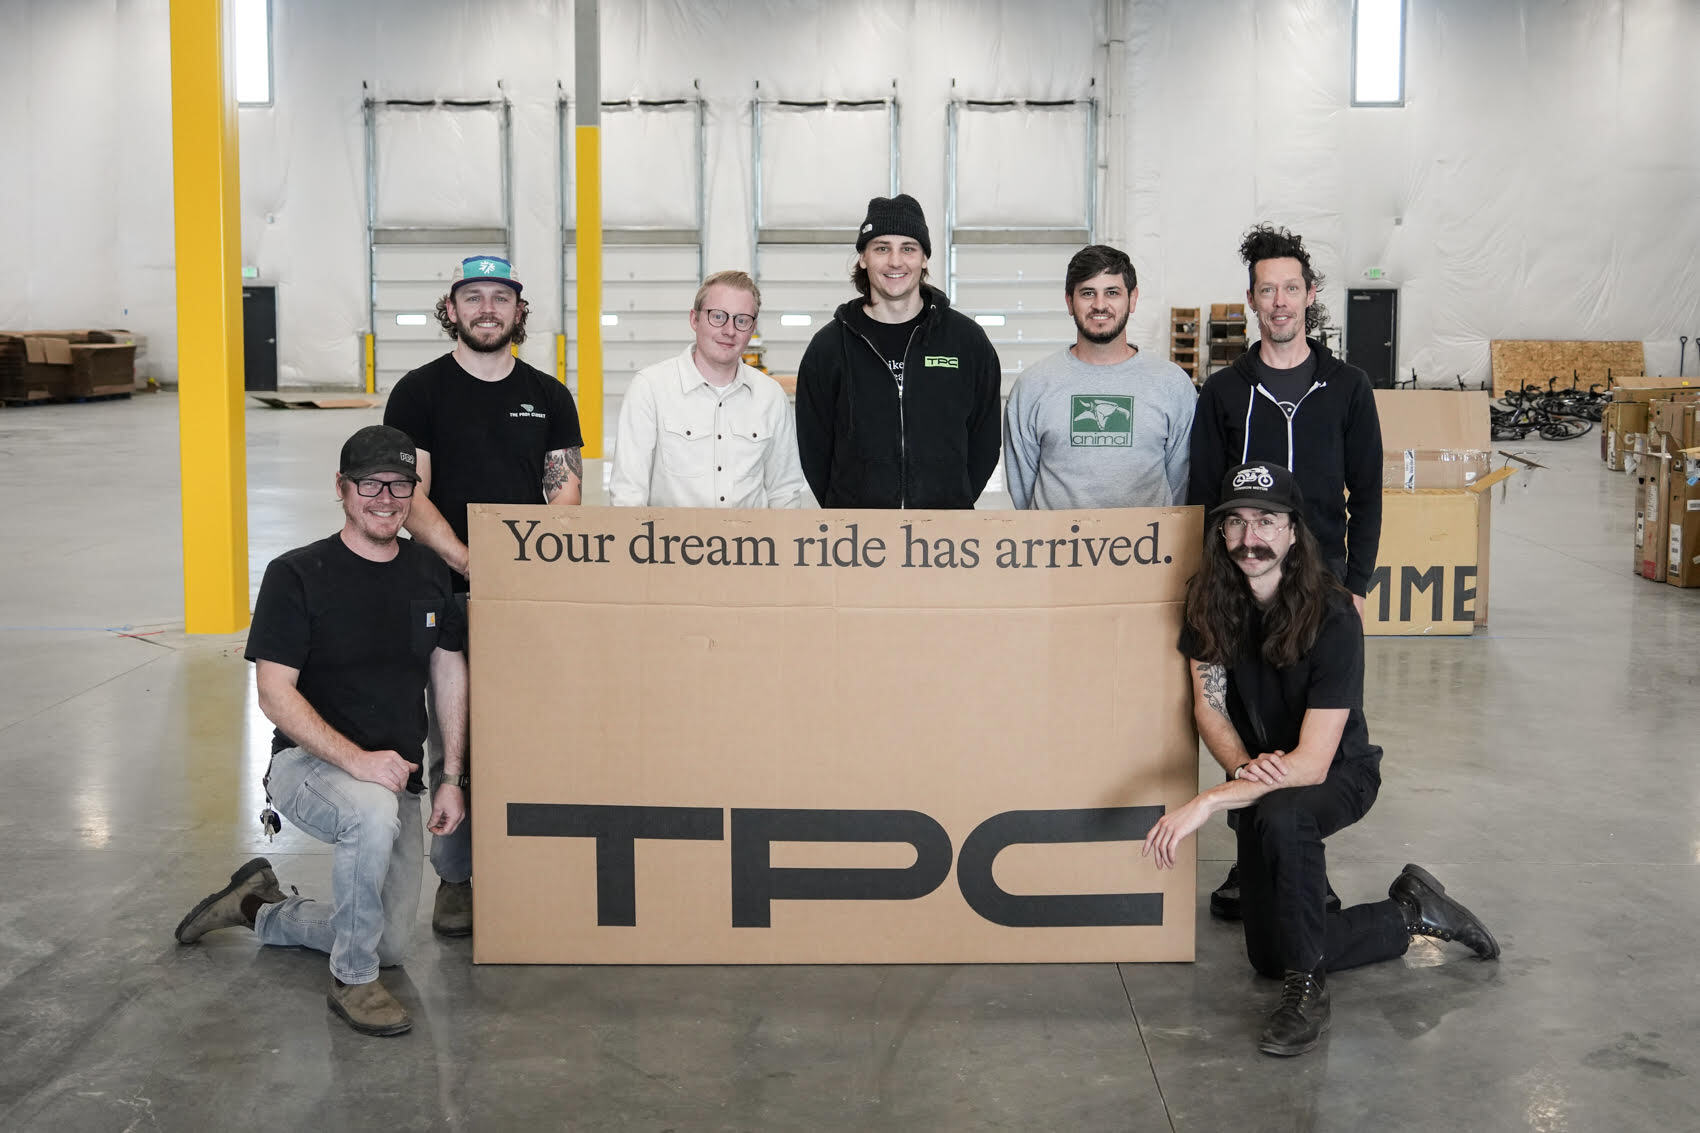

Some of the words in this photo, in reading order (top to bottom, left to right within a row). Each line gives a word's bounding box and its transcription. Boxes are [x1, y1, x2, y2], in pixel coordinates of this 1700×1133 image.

[925, 356, 958, 368] TPC
[1072, 432, 1129, 446] animal
[502, 519, 615, 563] Your
[628, 520, 779, 566] dream
[793, 523, 886, 568] ride
[900, 524, 980, 568] has
[995, 521, 1173, 569] arrived.
[507, 802, 1166, 928] TPC
